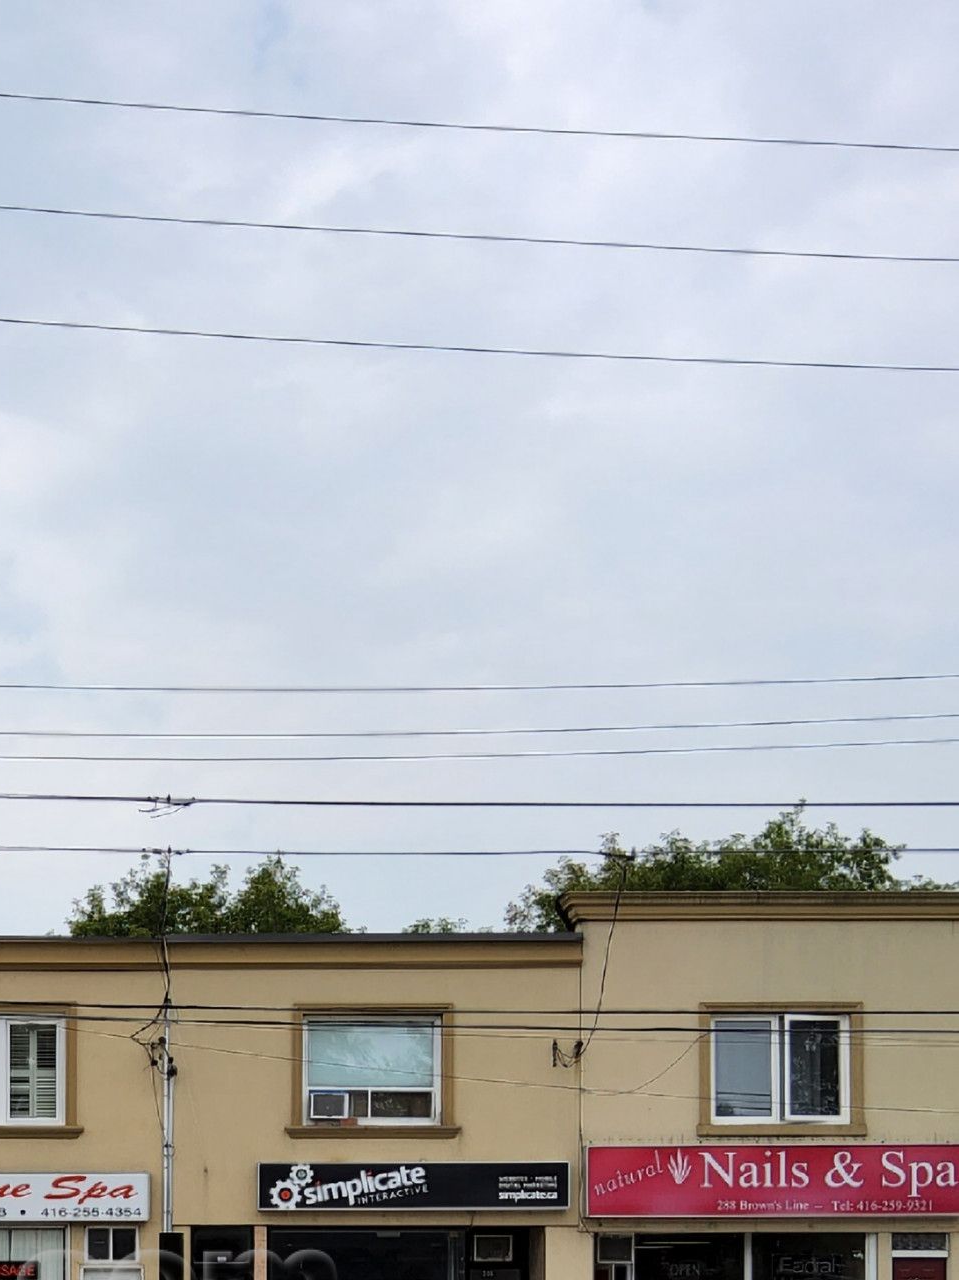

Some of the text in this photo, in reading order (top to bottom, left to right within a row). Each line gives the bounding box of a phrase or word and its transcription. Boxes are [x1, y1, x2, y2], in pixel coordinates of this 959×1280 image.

[303, 1165, 426, 1206] simplicate
[594, 1150, 663, 1196] natural
[698, 1150, 959, 1198] Nails & Spa
[44, 1175, 138, 1205] Spa
[356, 1184, 430, 1205] INTERACTIVE
[41, 1207, 142, 1218] 416-255-4354
[740, 1200, 782, 1211] Brown's
[785, 1200, 810, 1211] Line
[832, 1200, 854, 1212] Tel:
